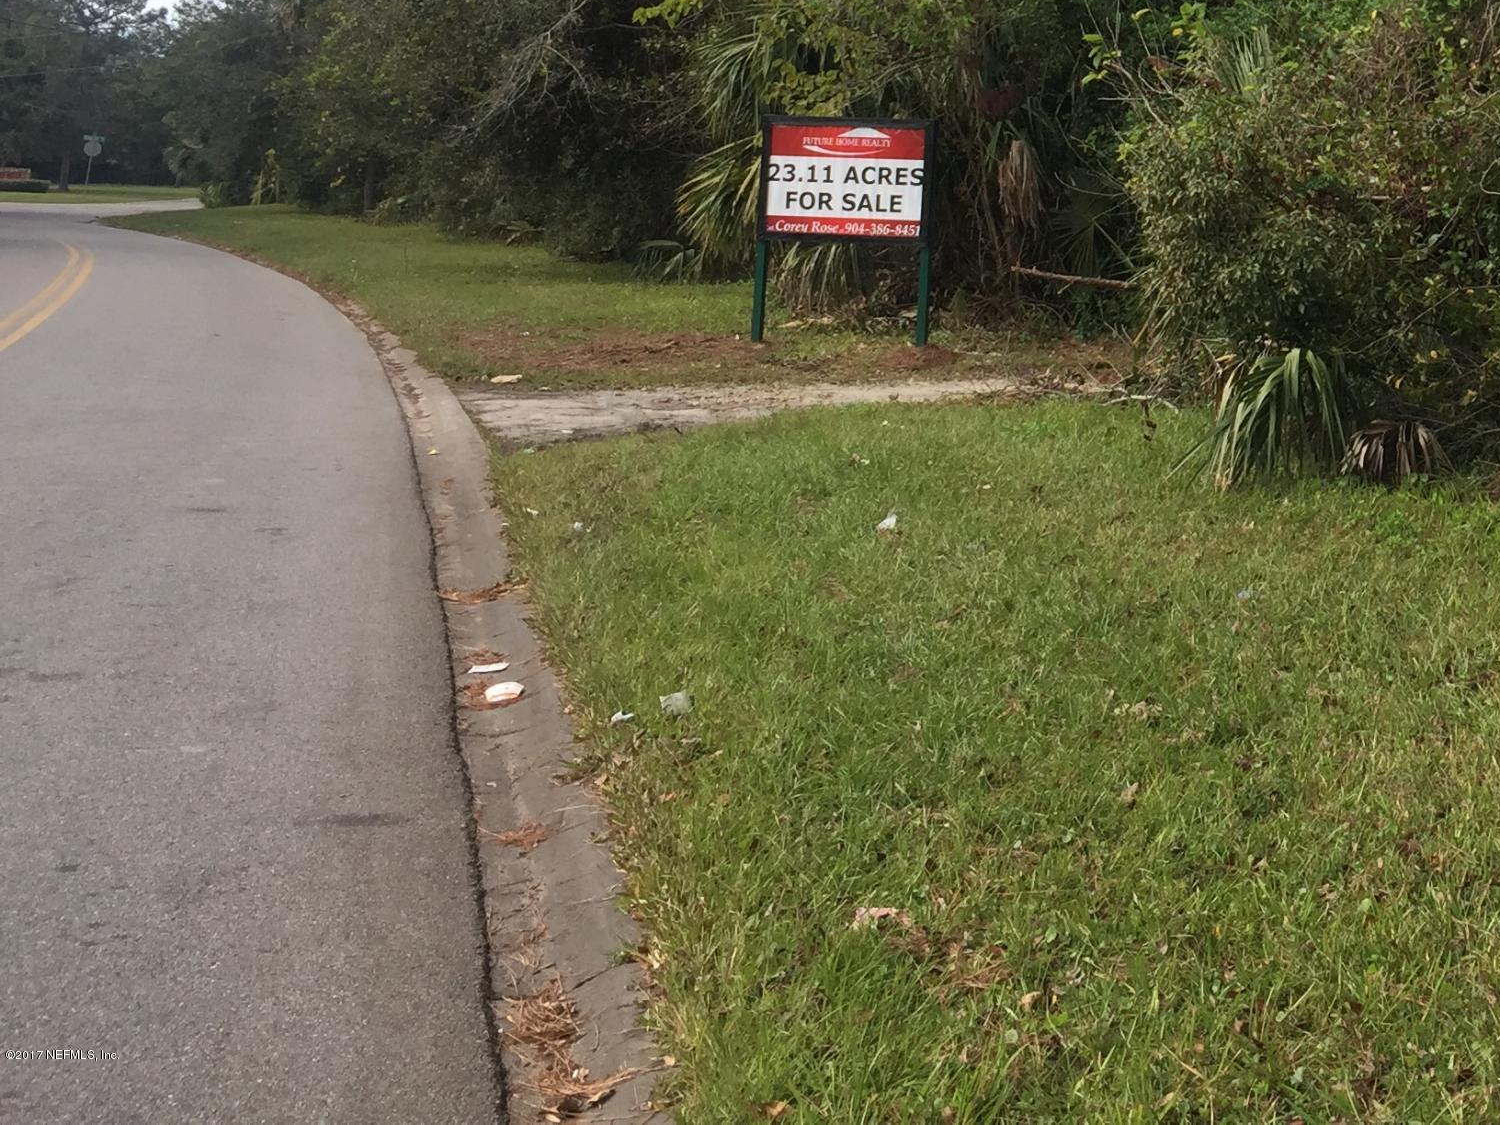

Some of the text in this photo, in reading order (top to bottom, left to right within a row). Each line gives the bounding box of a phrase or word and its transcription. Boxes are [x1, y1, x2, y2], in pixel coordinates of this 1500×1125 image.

[803, 136, 892, 148] FUTURE HOME REALTY
[768, 163, 925, 187] 23.11 ACRES
[785, 191, 903, 213] FOR SALE
[812, 221, 839, 234] Rose
